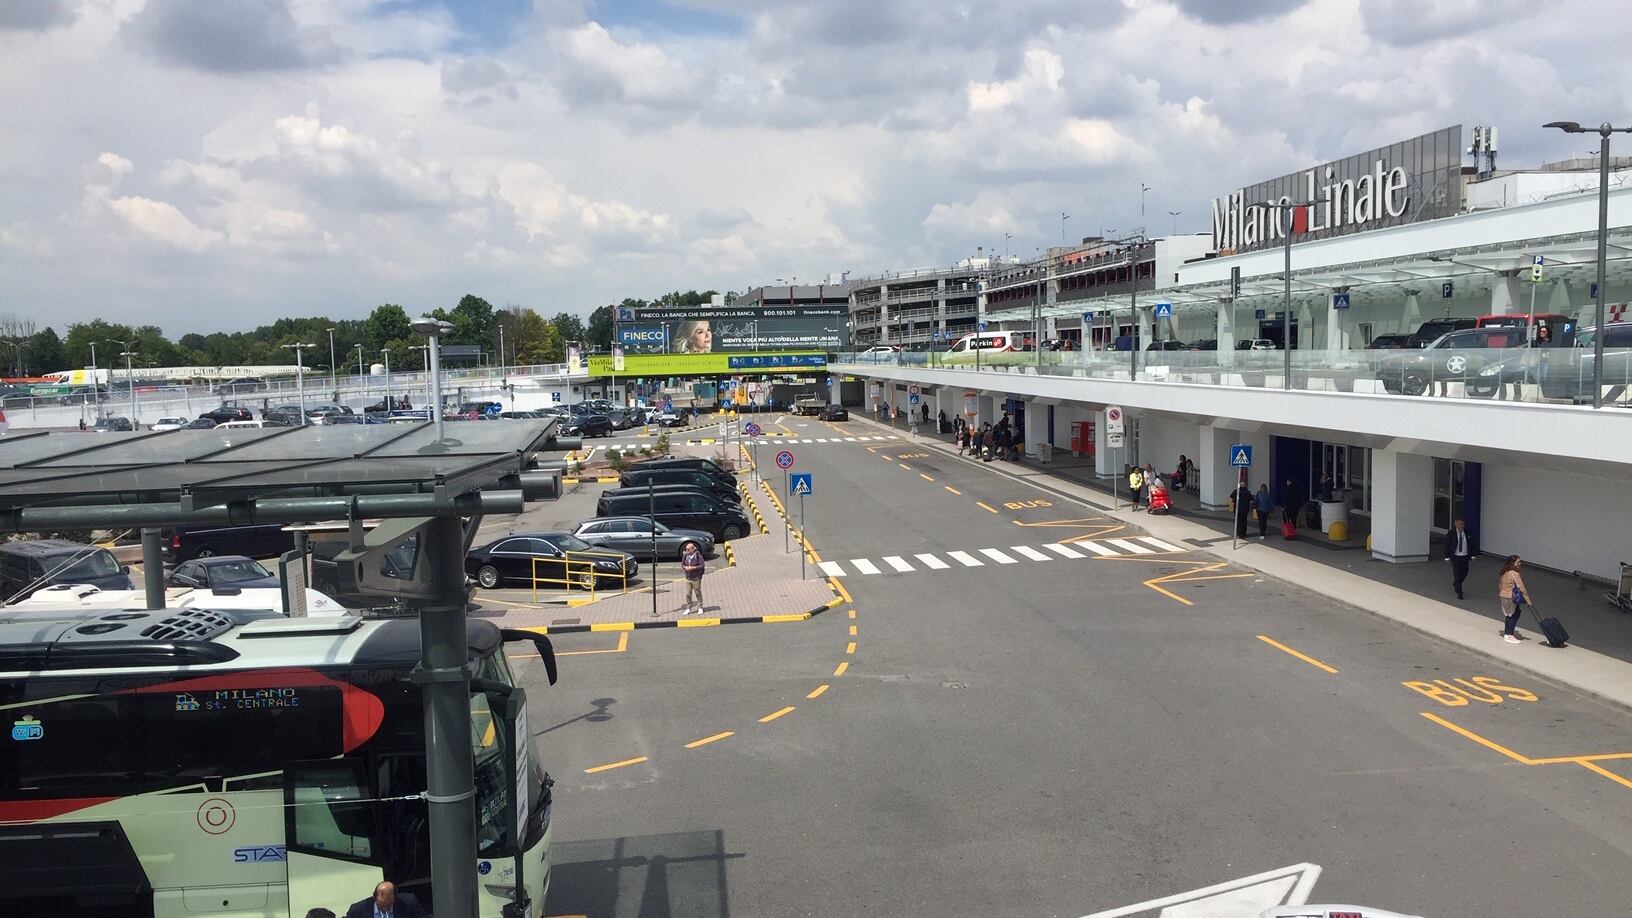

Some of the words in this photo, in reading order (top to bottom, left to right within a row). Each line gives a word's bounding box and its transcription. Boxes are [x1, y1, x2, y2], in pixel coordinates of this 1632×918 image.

[1211, 187, 1294, 251] Milano
[1306, 159, 1409, 232] Linate
[1564, 324, 1571, 333] P
[624, 331, 664, 340] FINECO
[1003, 500, 1053, 510] BUS
[215, 688, 296, 700] MILANO
[1401, 676, 1539, 707] BUS
[237, 697, 299, 709] CENTRALE
